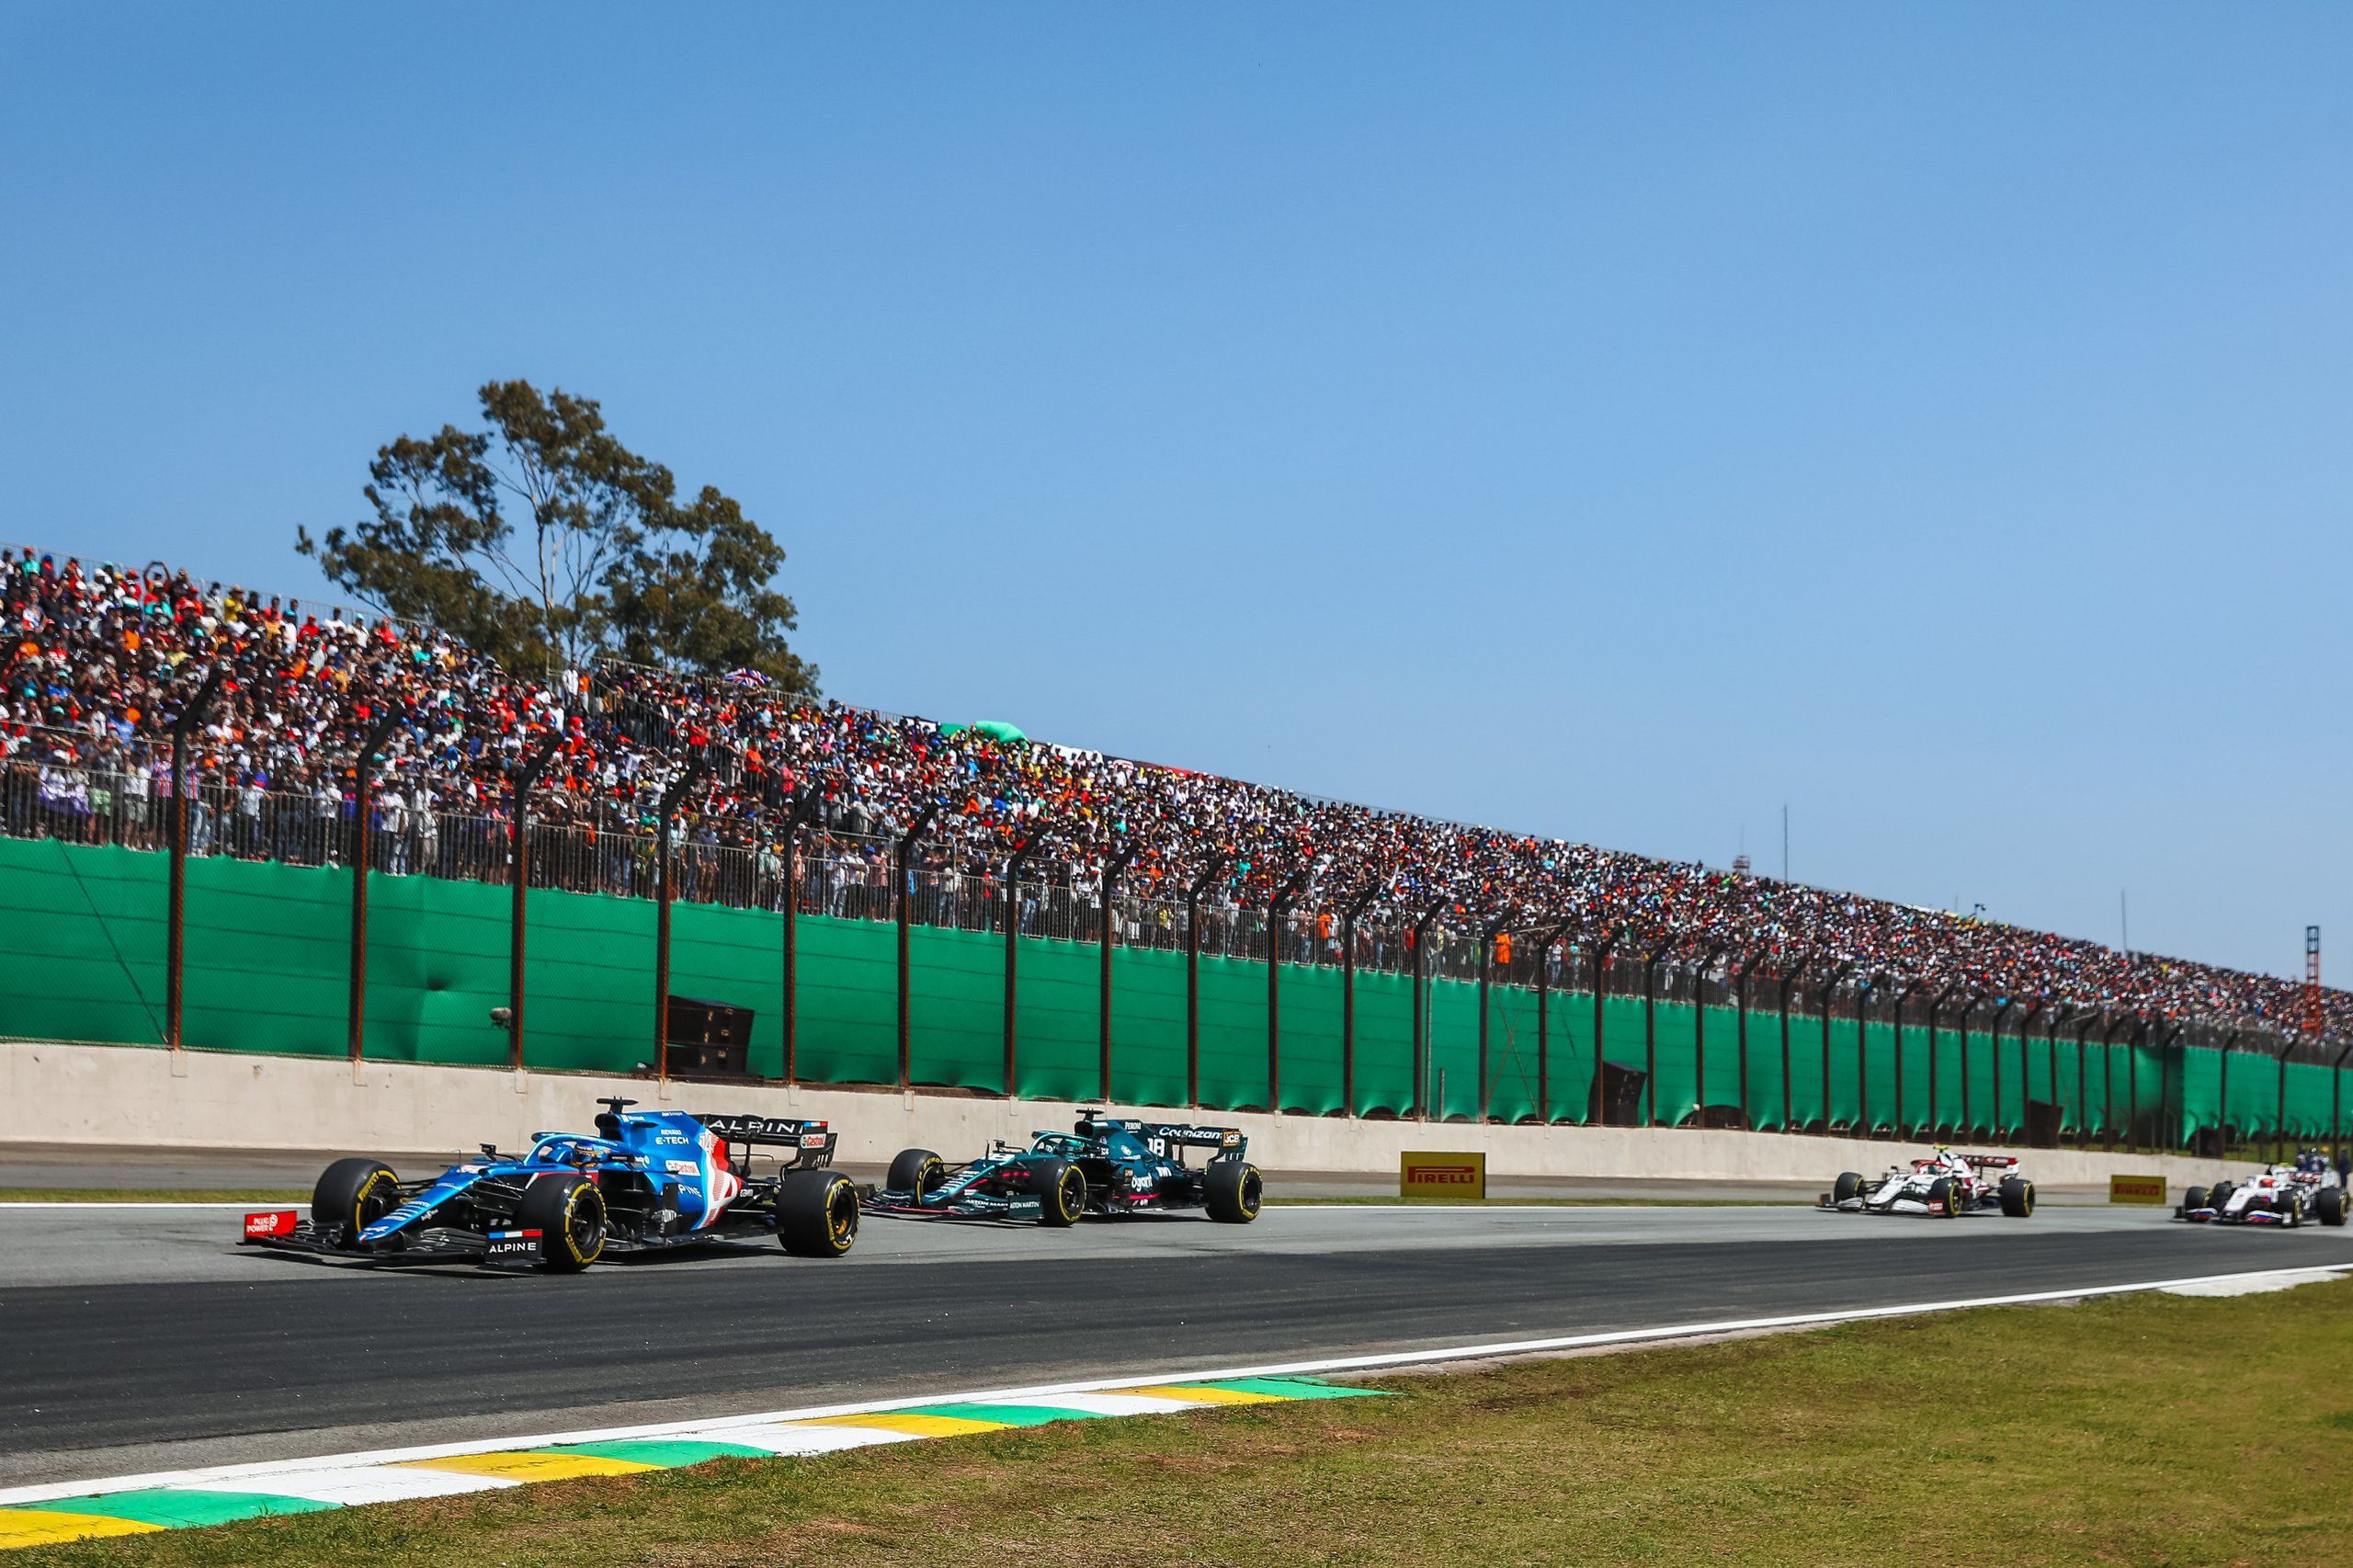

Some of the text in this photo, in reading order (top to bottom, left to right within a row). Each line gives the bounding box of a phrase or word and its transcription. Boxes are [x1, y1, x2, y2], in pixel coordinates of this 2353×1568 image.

[655, 1136, 689, 1145] E-TECH
[805, 1135, 824, 1146] Castrol
[1225, 1133, 1240, 1143] JCB
[1147, 1138, 1165, 1157] 18
[674, 1163, 699, 1174] Castrol
[1407, 1166, 1475, 1184] PIRELLI
[677, 1184, 702, 1199] PINE
[488, 1242, 537, 1254] ALPINE
